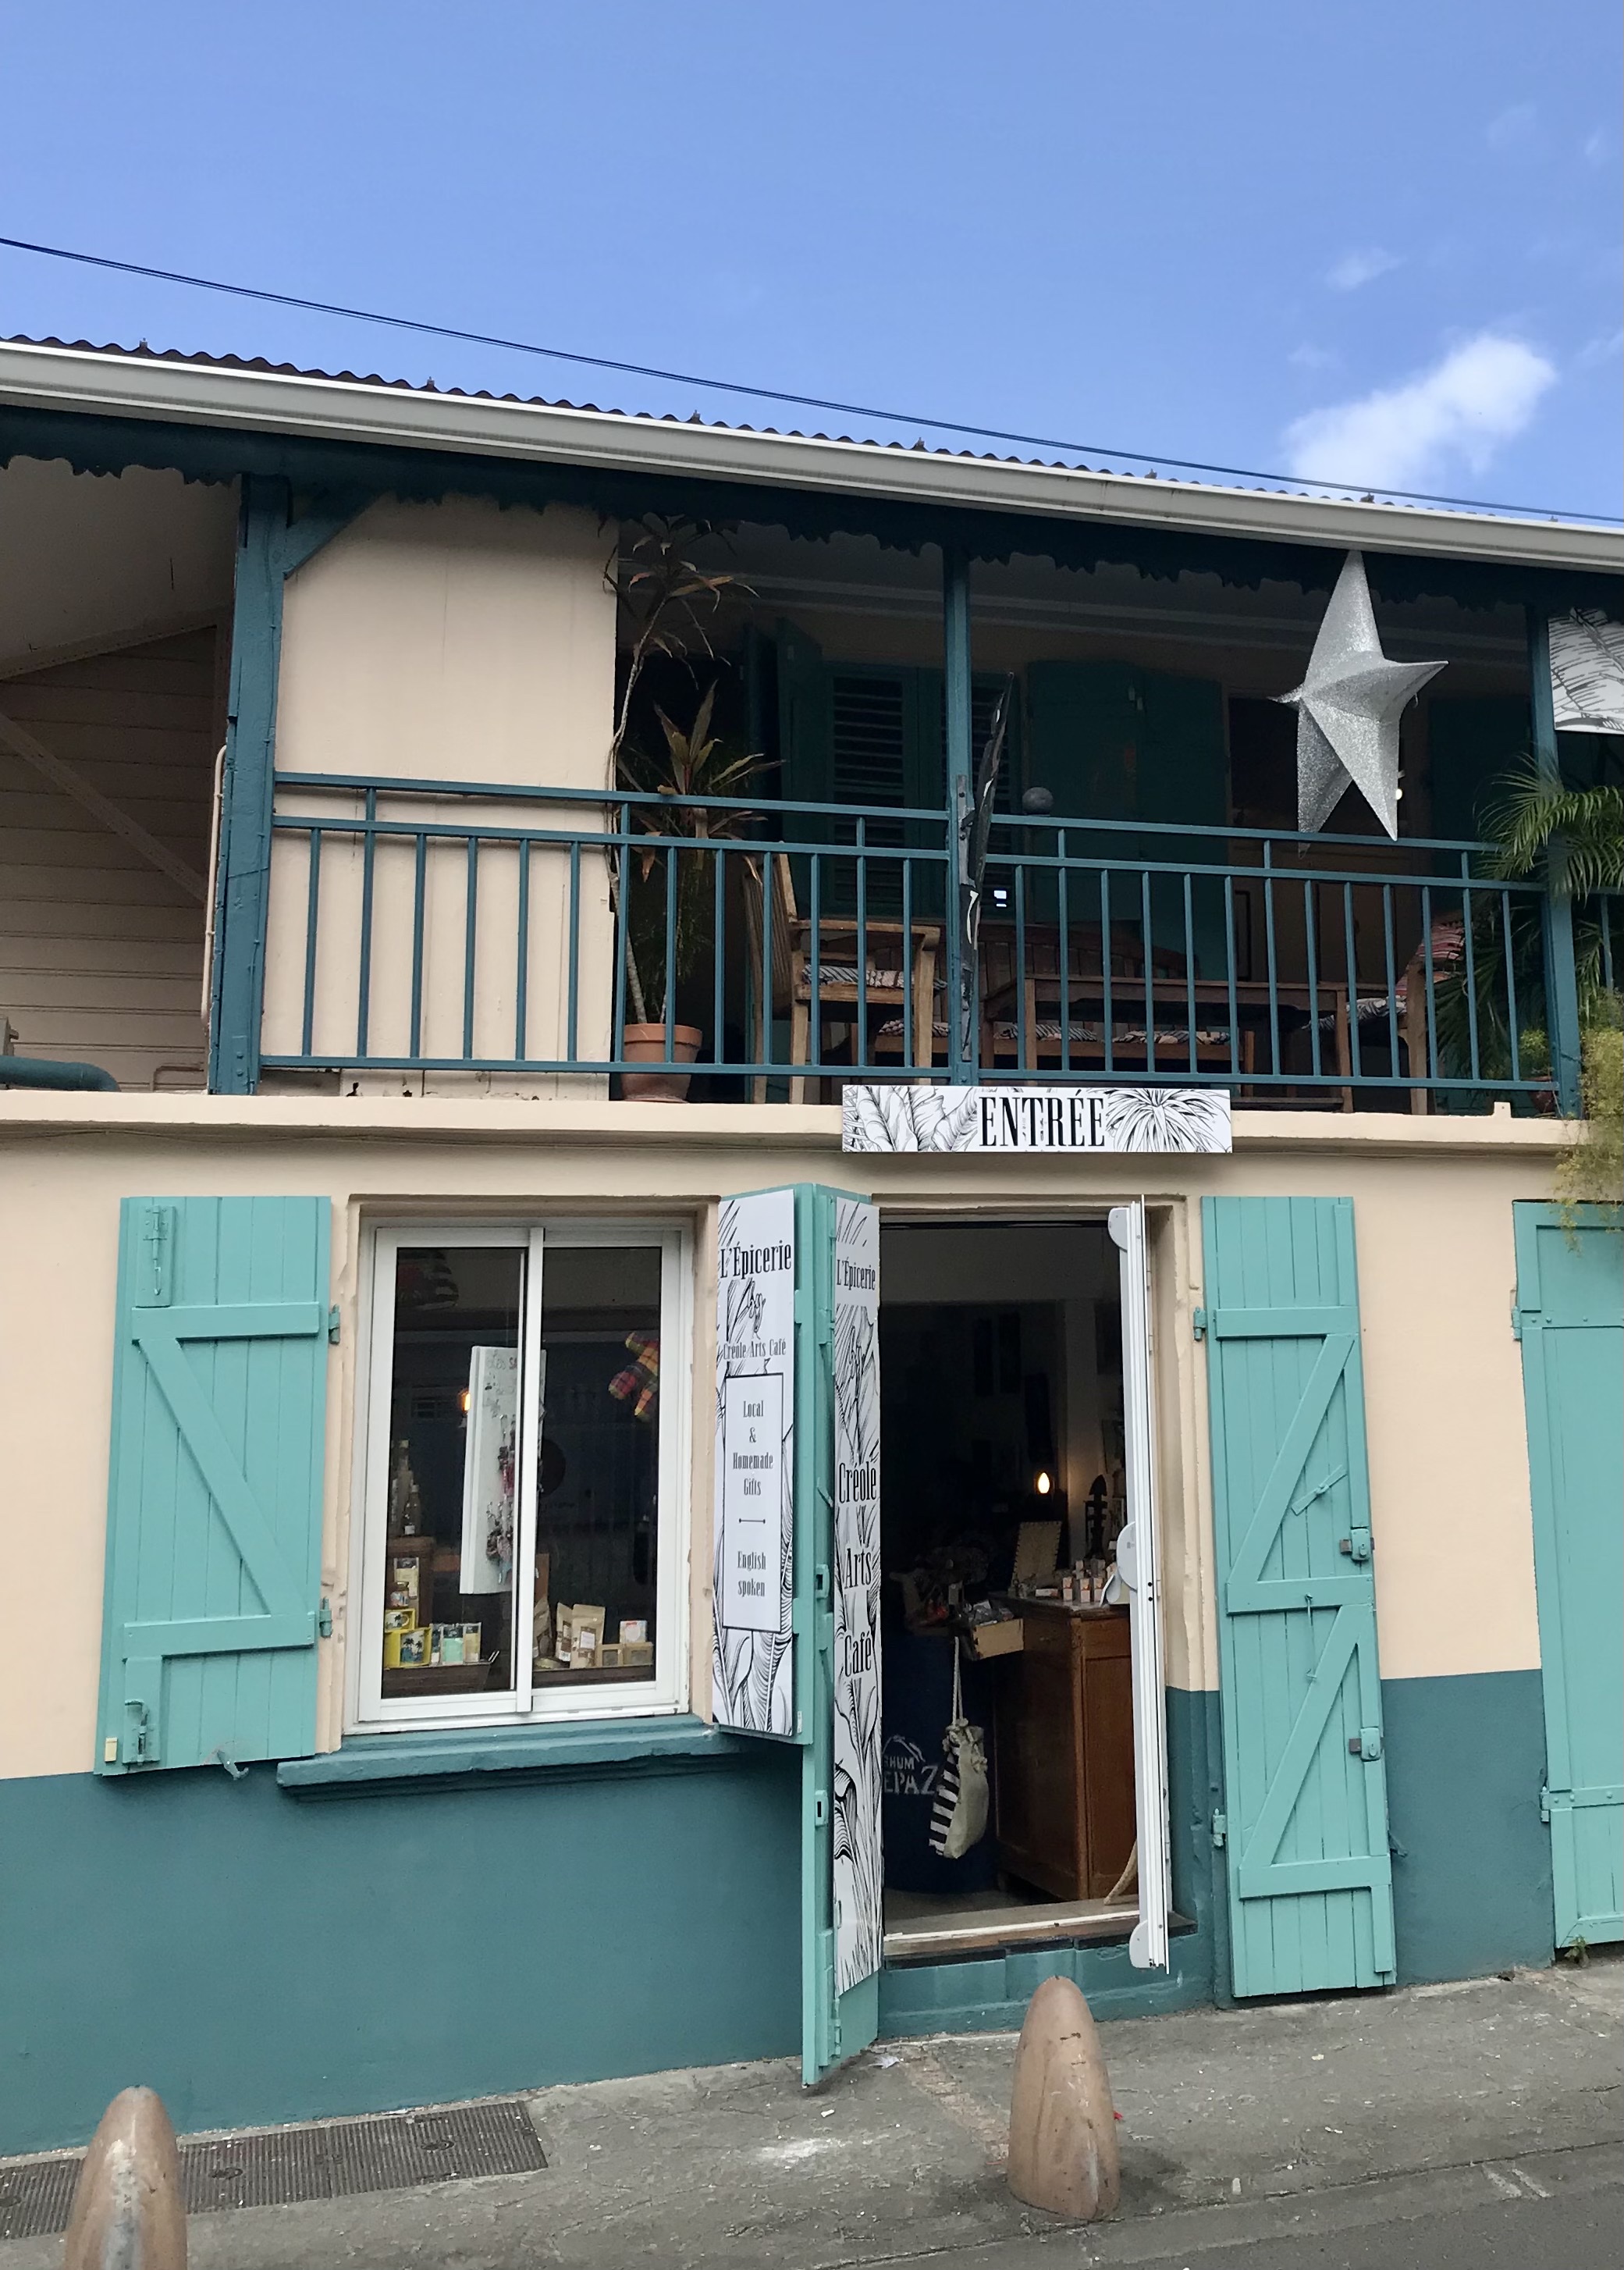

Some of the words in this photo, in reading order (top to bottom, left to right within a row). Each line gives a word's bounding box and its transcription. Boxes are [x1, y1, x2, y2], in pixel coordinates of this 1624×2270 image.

[979, 1089, 1105, 1147] ENTRÉE
[720, 1240, 792, 1280] L'Épicerie
[837, 1256, 876, 1290] L'Épicerie
[723, 1342, 747, 1360] Créole
[750, 1340, 766, 1358] Arts
[769, 1338, 787, 1356] Café
[743, 1400, 764, 1418] Local
[749, 1427, 757, 1443] &
[733, 1451, 773, 1469] Homemade
[744, 1478, 762, 1496] Gifts
[838, 1462, 877, 1503] Créole
[737, 1550, 766, 1571] English
[844, 1547, 872, 1590] Arts
[737, 1578, 766, 1597] spoken
[844, 1631, 872, 1677] Café
[883, 1765, 938, 1795] EPAZ
